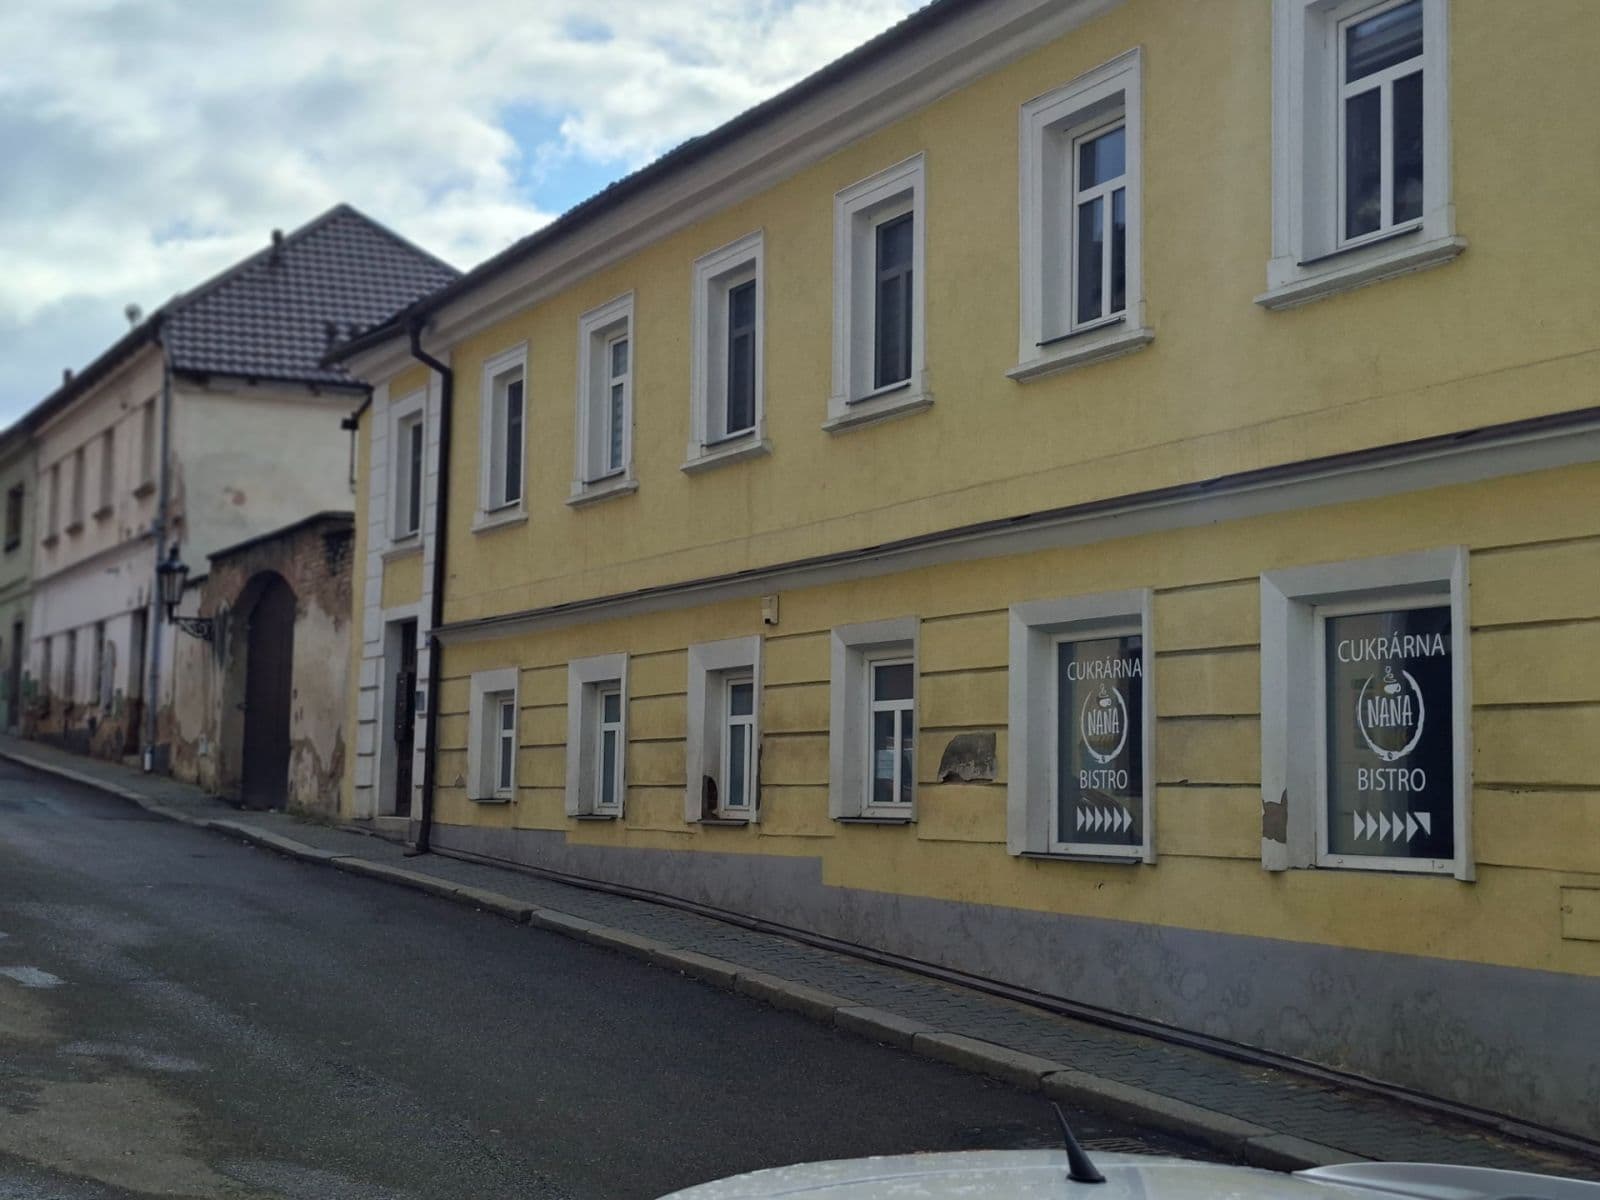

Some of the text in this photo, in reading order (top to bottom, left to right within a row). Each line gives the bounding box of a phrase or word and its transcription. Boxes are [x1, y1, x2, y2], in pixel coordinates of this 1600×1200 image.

[1338, 632, 1446, 662] CUKRÁRNA
[1067, 656, 1142, 681] CUKRÁRNA
[1087, 708, 1120, 736] NANA
[1367, 695, 1414, 728] NANA
[1079, 769, 1128, 789] BISTRO
[1358, 768, 1426, 792] BISTRO
